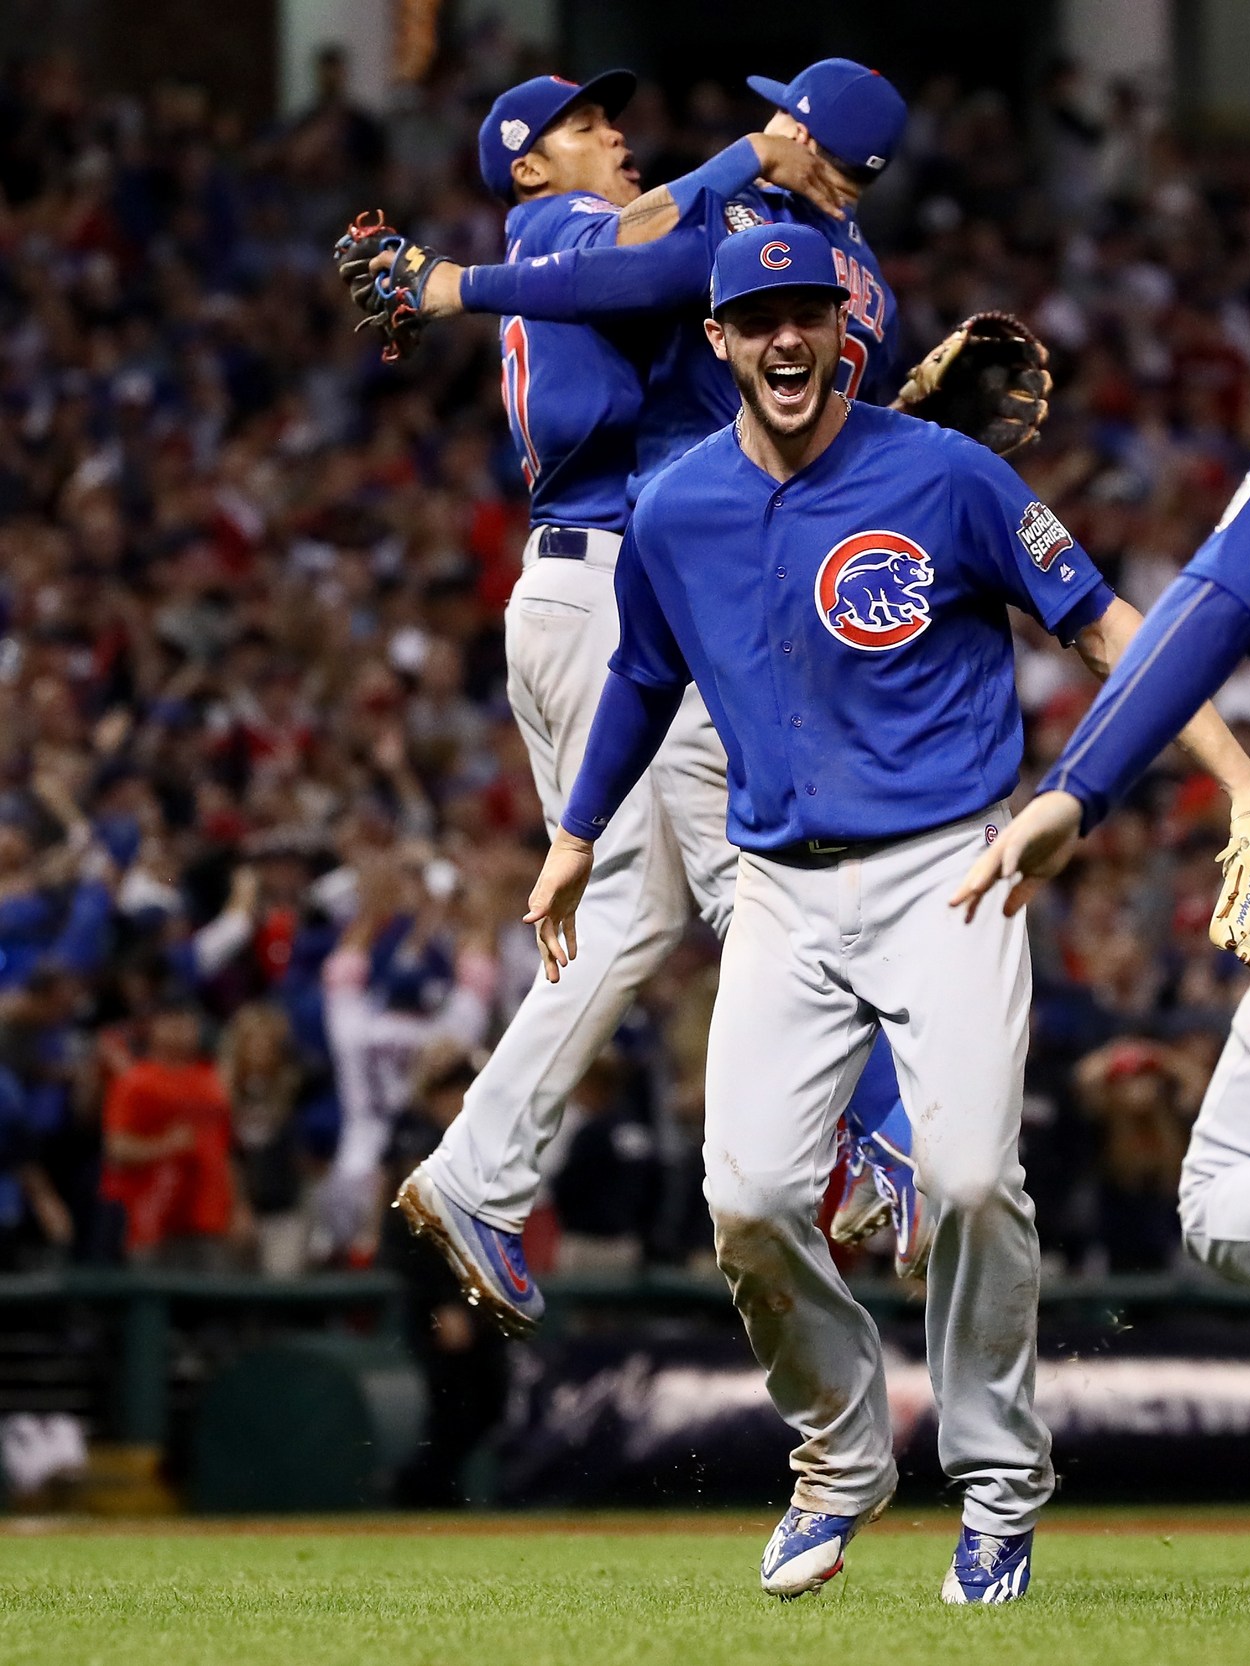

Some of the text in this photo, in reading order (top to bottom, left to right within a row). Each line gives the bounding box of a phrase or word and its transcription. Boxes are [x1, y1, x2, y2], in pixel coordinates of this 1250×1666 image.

[760, 240, 792, 271] C
[1021, 508, 1056, 545] WORLD
[1030, 521, 1067, 562] SERIES
